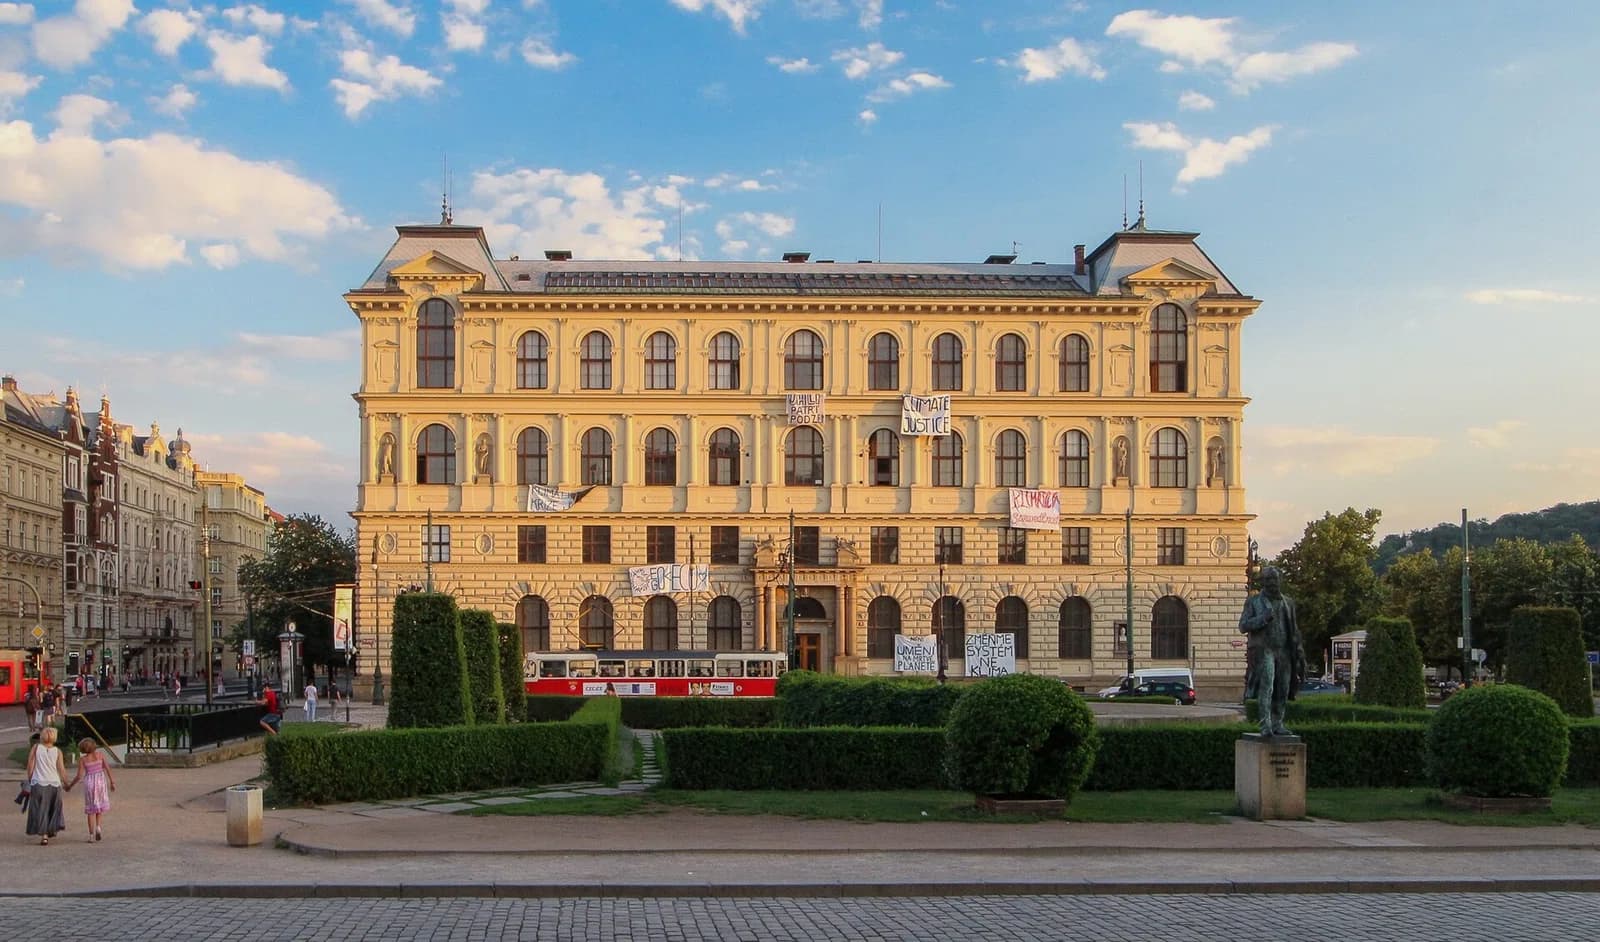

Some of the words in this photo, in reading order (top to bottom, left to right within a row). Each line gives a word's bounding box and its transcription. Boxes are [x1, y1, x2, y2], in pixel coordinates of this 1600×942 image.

[903, 394, 949, 412] CLIMATE
[903, 416, 949, 433] JUSTICE
[980, 657, 998, 667] NE
[971, 664, 1009, 677] KLIMA
